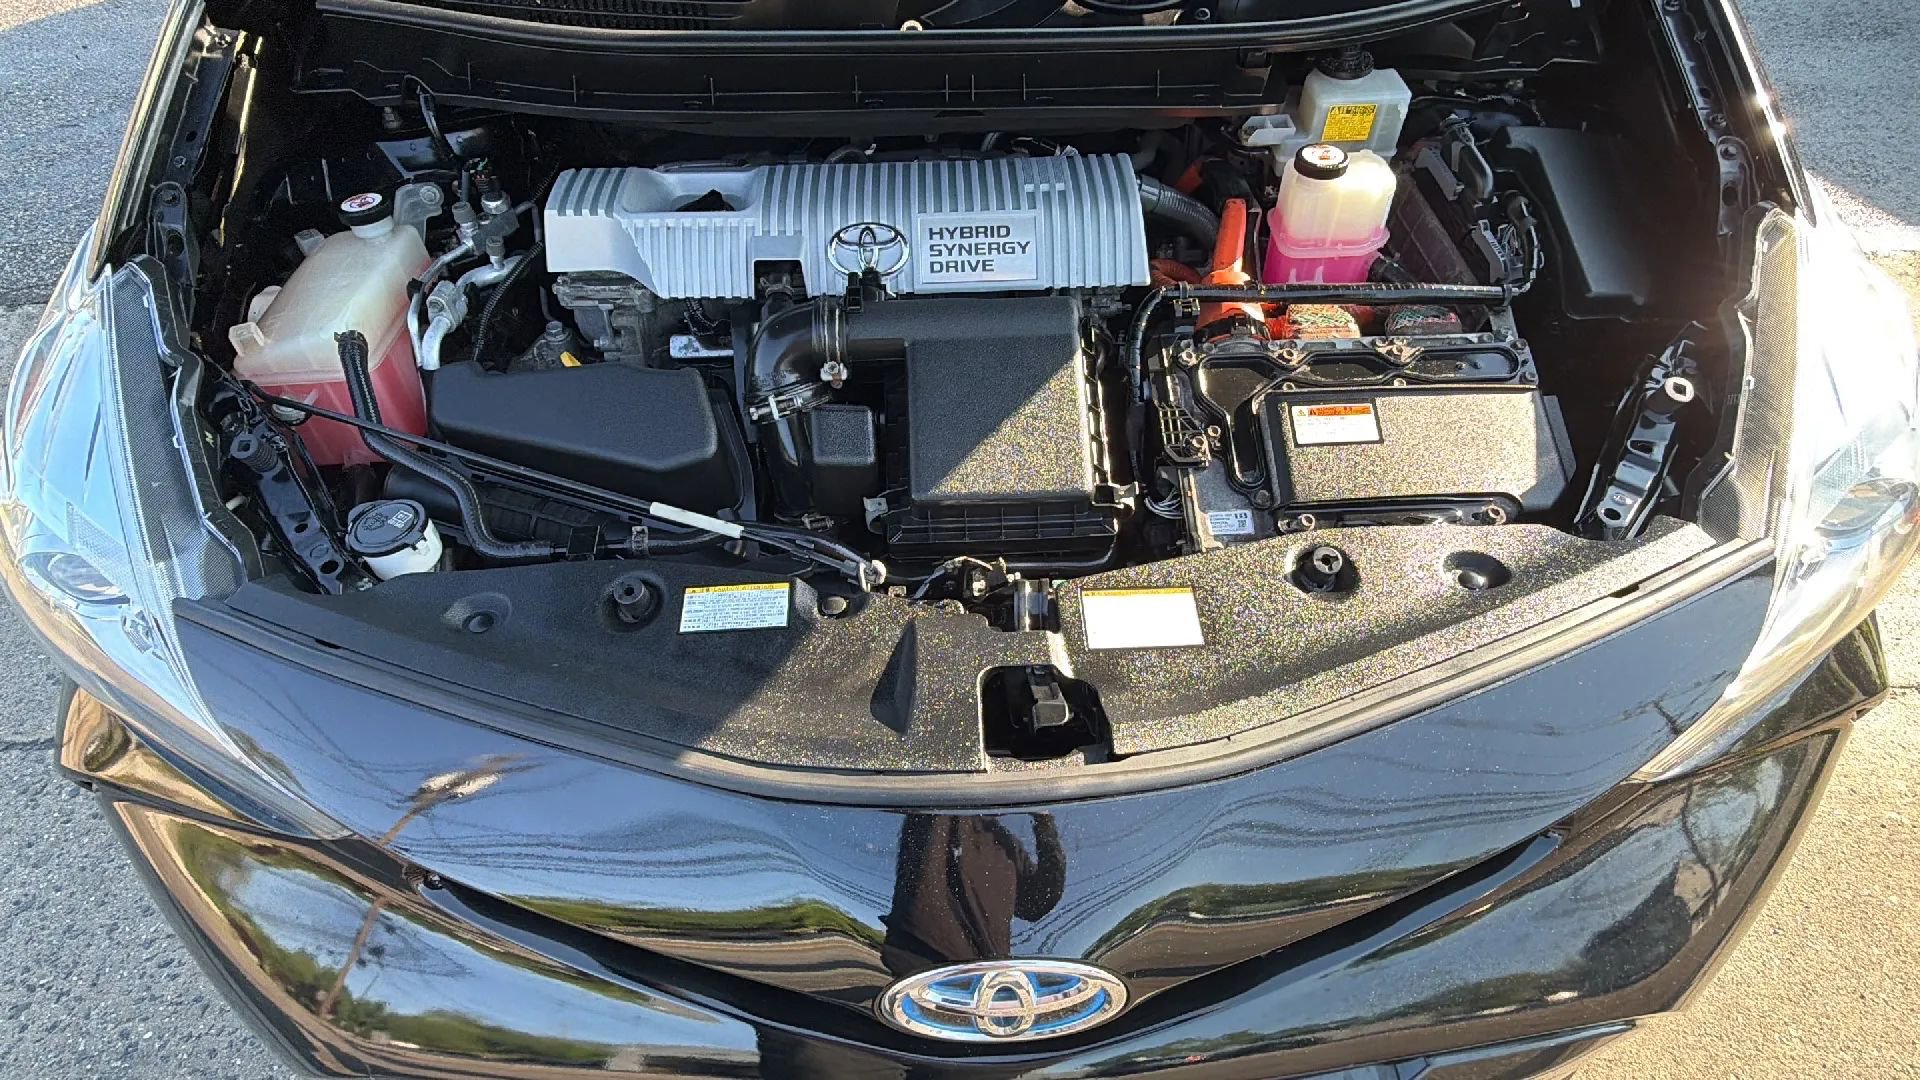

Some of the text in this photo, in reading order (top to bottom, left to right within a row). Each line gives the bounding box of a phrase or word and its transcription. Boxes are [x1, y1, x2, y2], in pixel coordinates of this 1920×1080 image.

[928, 225, 1011, 240] HYBRID
[929, 241, 1031, 257] SYNERGY
[929, 259, 995, 274] DRIVE
